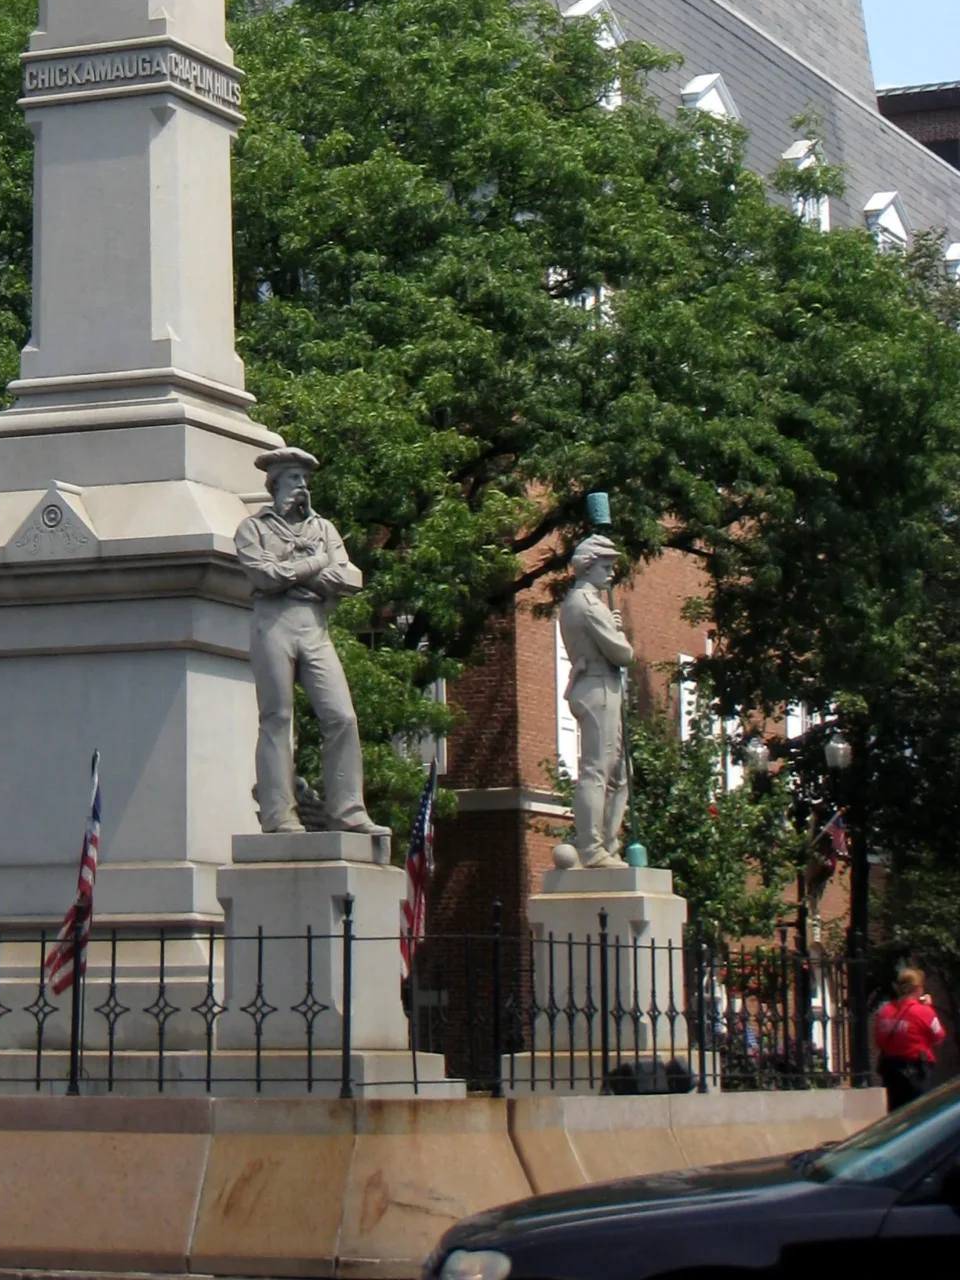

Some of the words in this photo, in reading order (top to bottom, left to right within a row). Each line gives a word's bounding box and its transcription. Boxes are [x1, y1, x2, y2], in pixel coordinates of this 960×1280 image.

[25, 54, 167, 91] CHICKAMAUGA
[171, 53, 214, 94] CHAPLIN
[214, 73, 241, 106] HILLS
